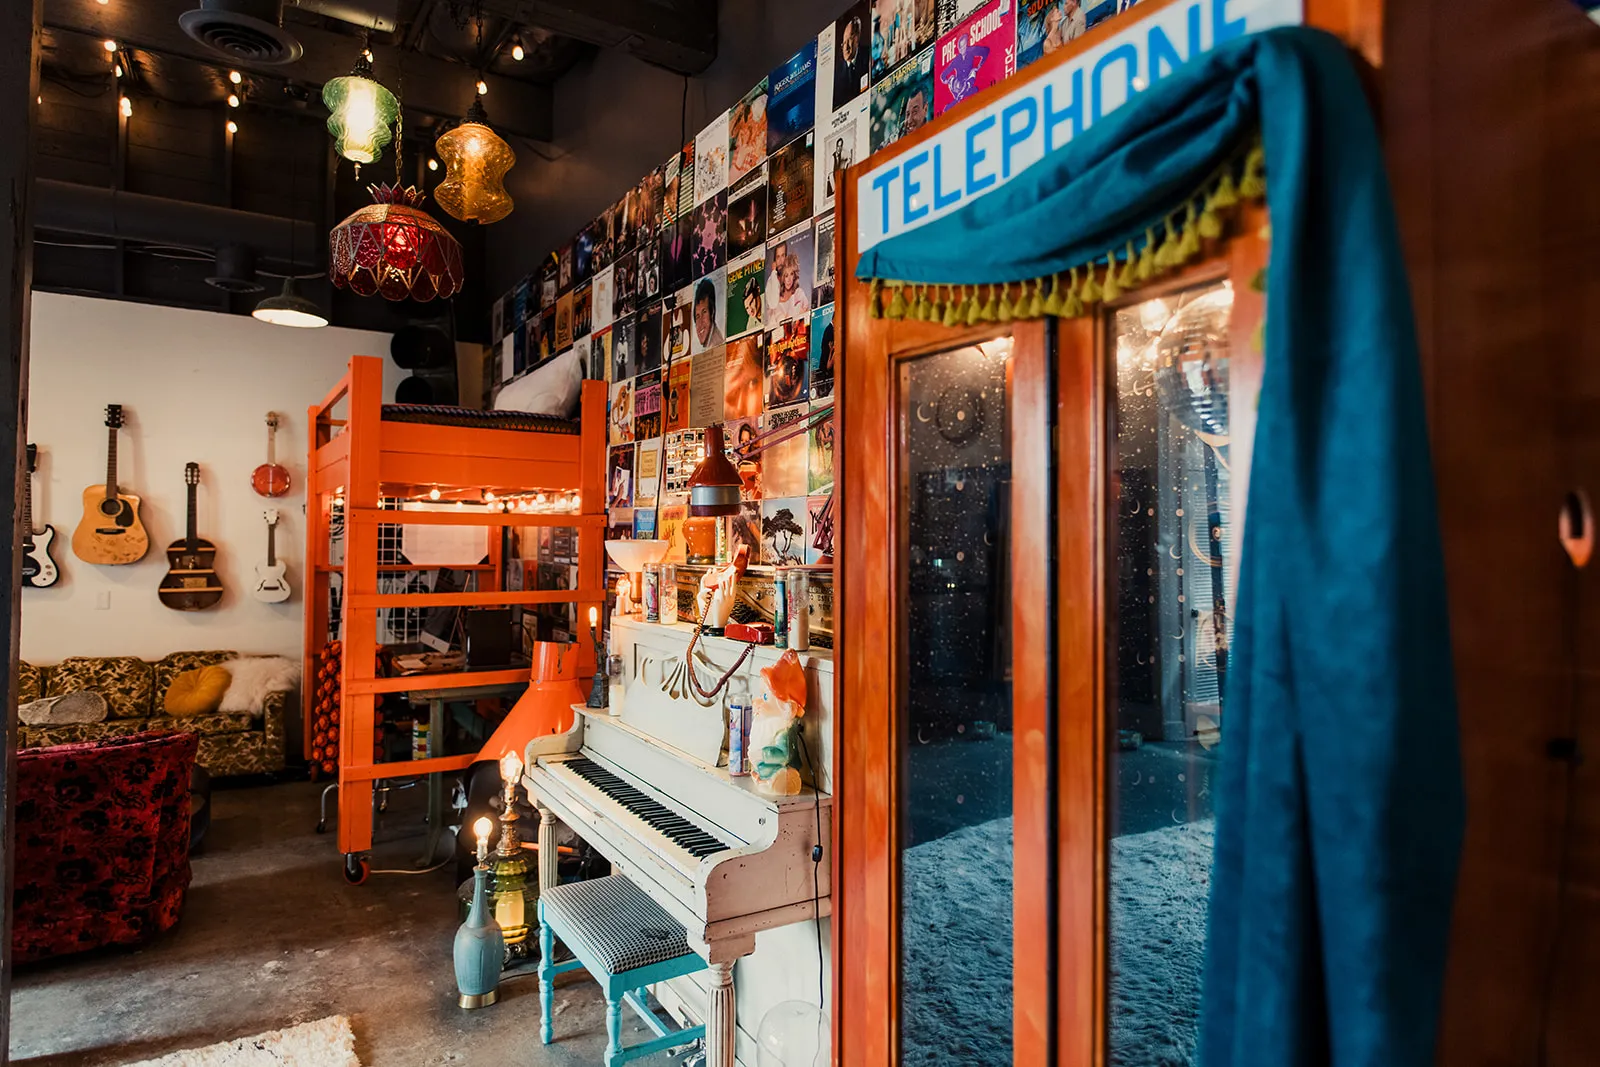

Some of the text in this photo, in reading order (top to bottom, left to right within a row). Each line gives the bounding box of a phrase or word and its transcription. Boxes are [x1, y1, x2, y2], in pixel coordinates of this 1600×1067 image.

[942, 7, 1003, 66] PRE SCHOOL
[728, 268, 743, 284] GENE
